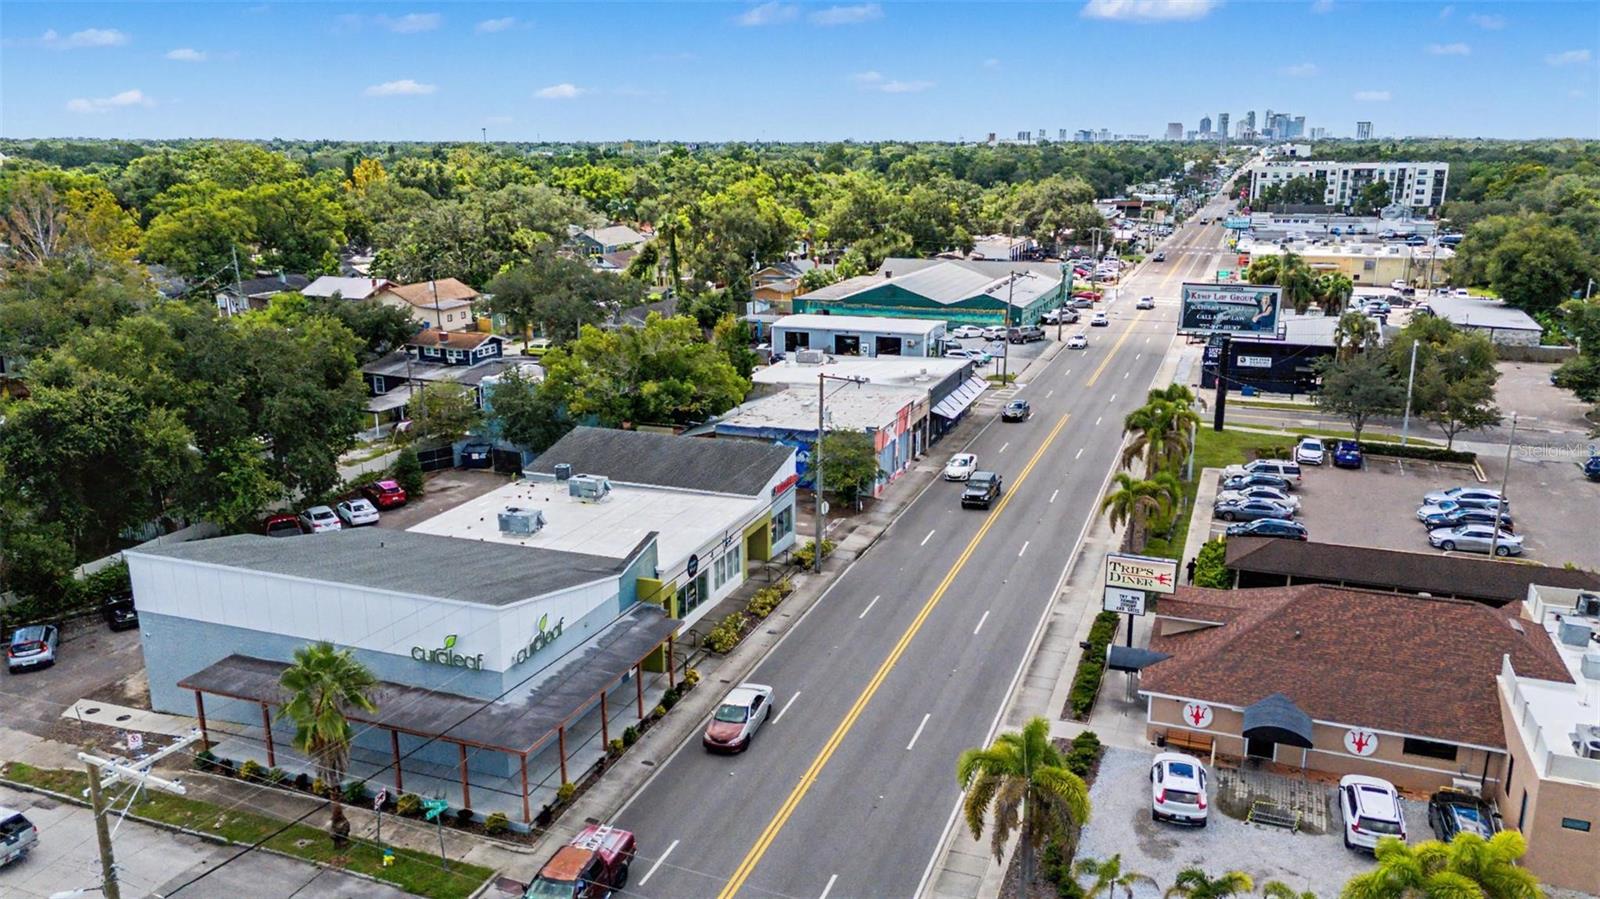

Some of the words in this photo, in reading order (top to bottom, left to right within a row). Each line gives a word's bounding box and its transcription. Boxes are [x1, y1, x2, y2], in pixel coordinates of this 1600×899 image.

[1230, 293, 1254, 302] GROUP
[1109, 572, 1153, 587] DINER
[517, 617, 564, 664] curaleaf
[411, 646, 484, 671] curaleaf
